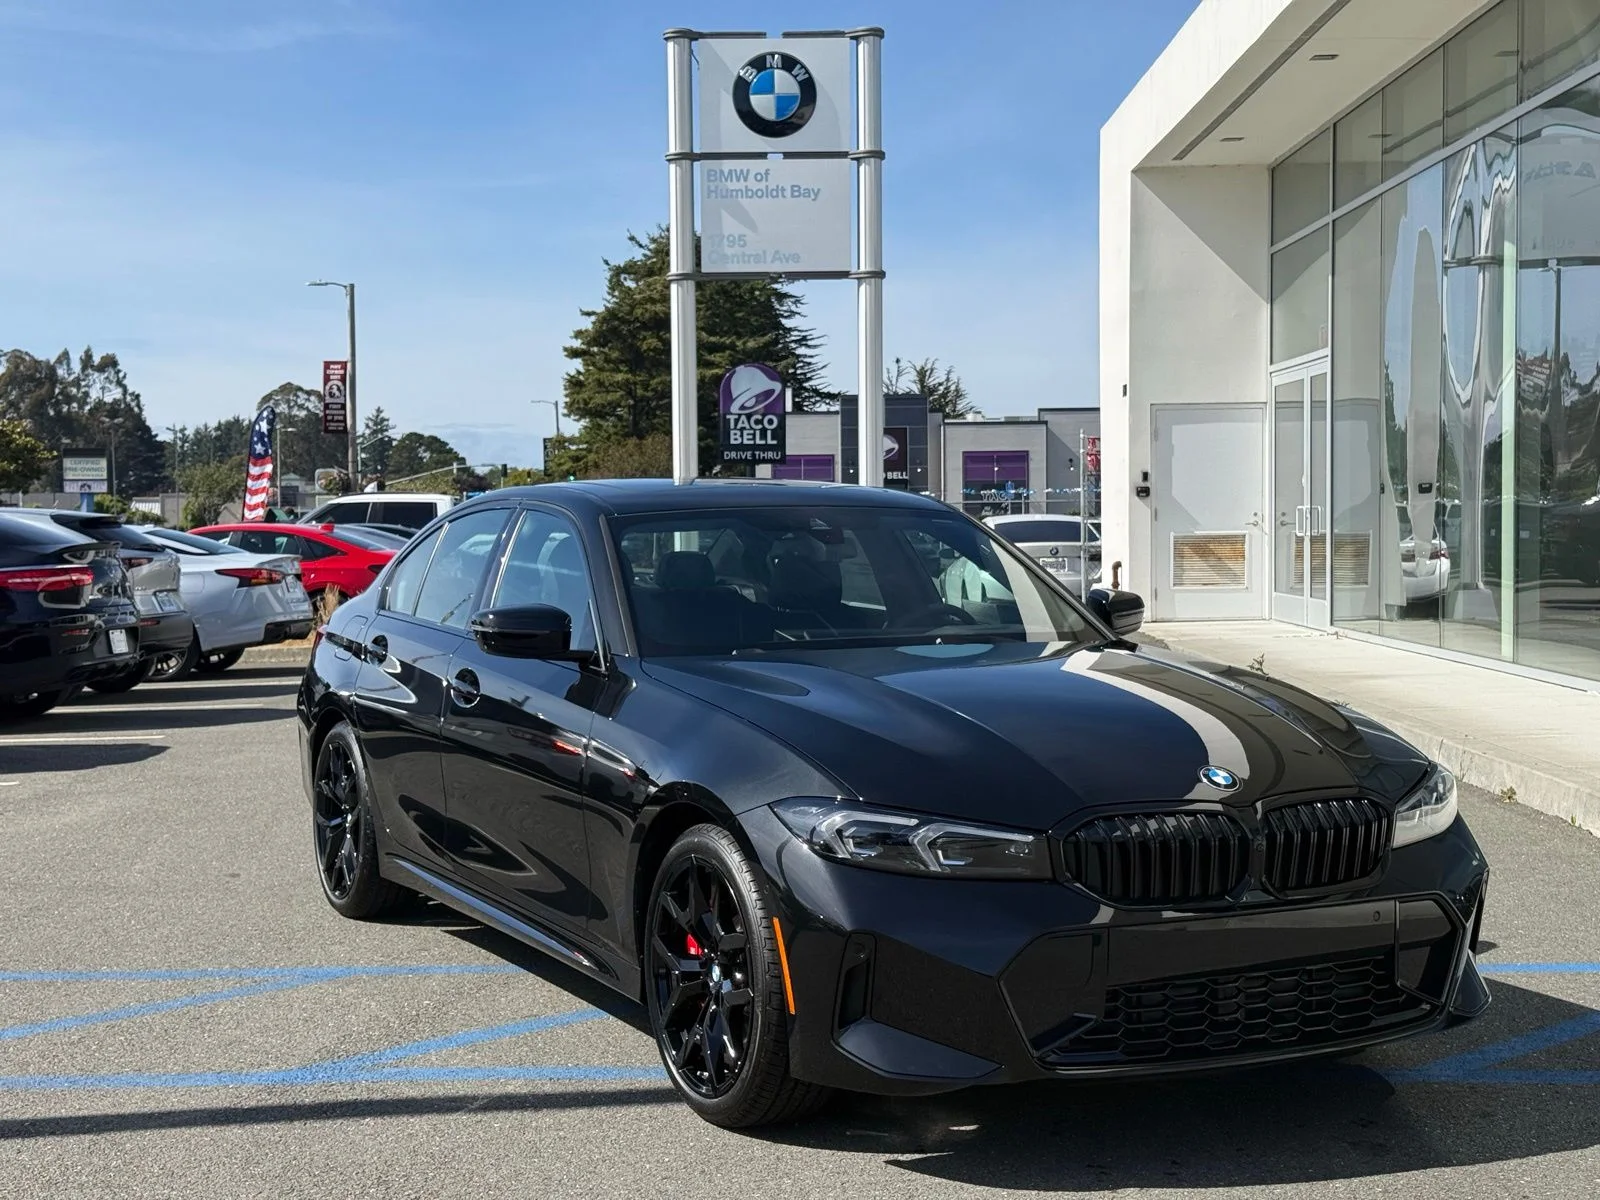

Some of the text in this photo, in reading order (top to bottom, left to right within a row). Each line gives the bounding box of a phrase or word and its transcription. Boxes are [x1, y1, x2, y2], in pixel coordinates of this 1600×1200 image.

[739, 54, 809, 82] BMW
[706, 168, 771, 183] BMW of
[706, 184, 821, 202] Humboldt Bay
[708, 234, 747, 249] 1795
[707, 250, 801, 265] Central Ave
[726, 414, 778, 430] TACO
[730, 430, 778, 445] BELL
[724, 451, 781, 460] DRIVE THRU
[886, 471, 909, 480] BELL
